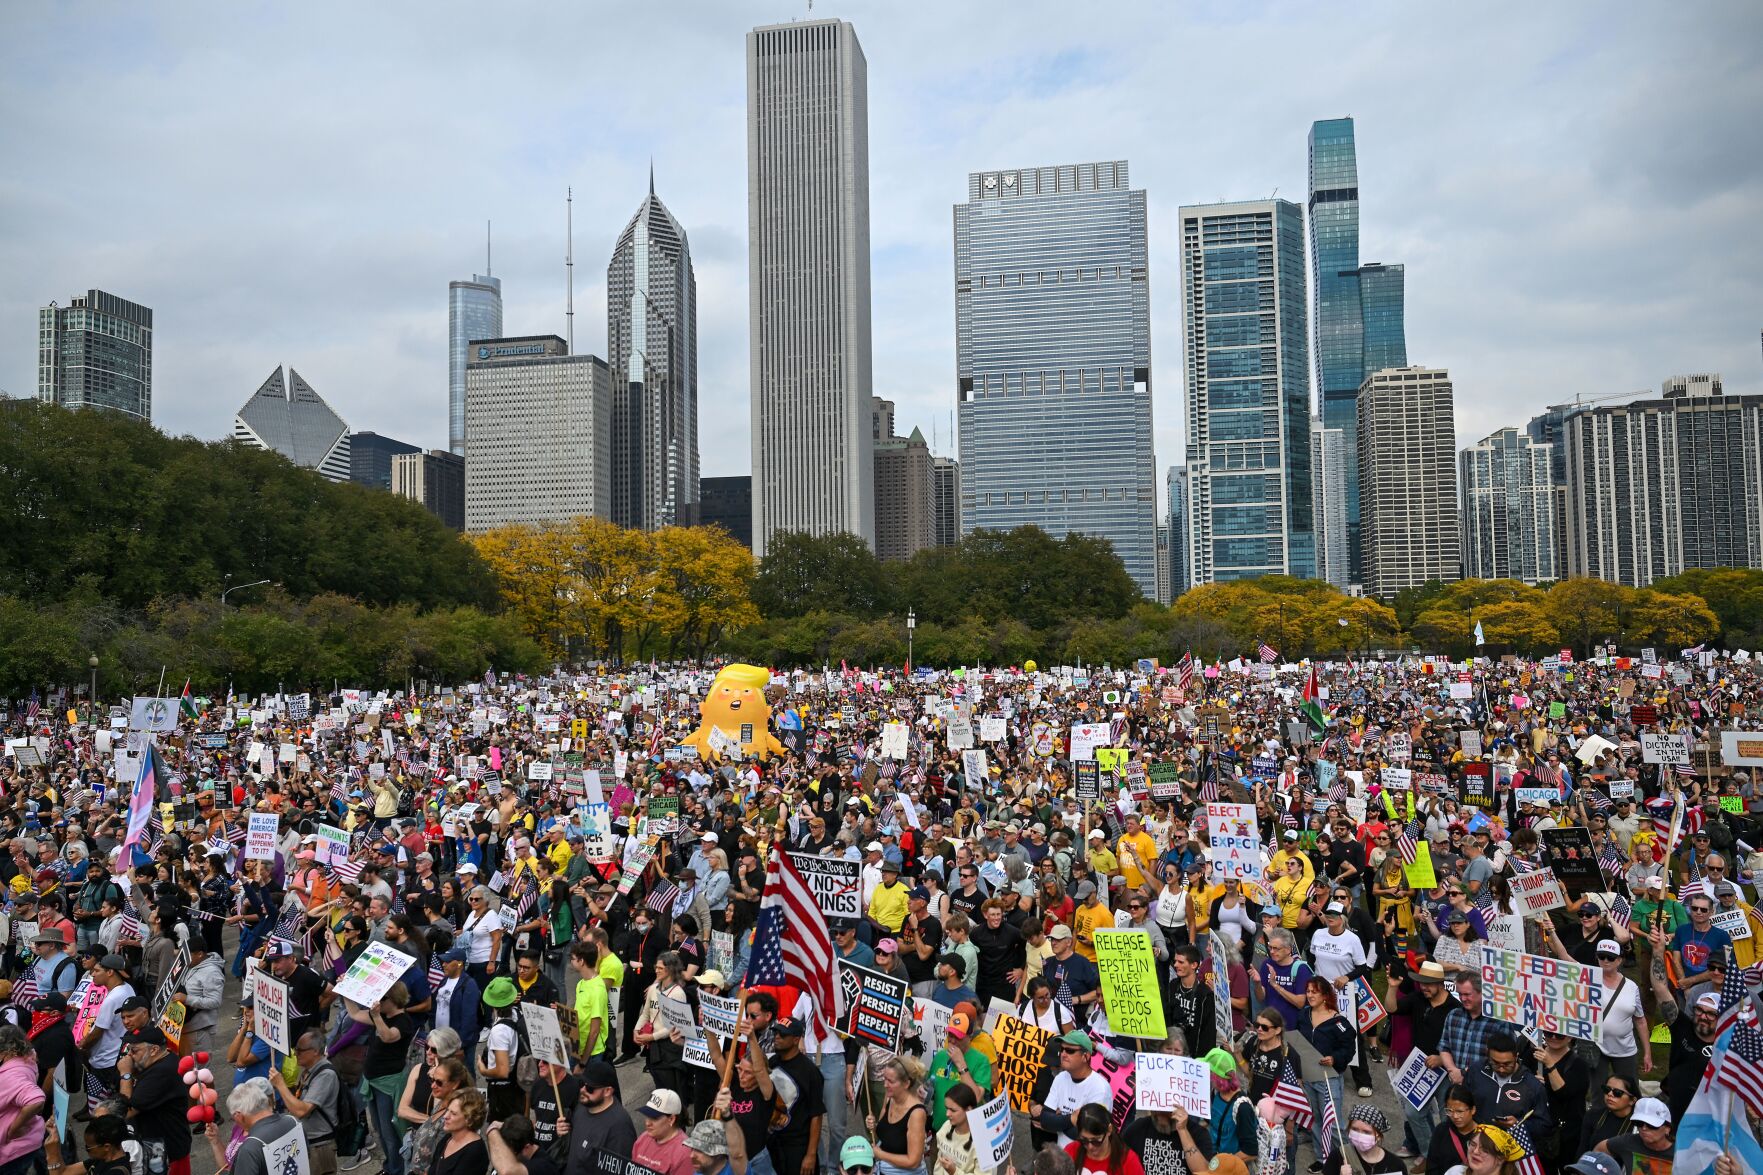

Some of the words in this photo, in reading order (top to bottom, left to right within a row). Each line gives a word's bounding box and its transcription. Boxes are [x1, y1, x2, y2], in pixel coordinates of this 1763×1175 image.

[495, 344, 544, 355] Prudential
[1645, 741, 1685, 749] DICTATOR
[1149, 767, 1176, 775] CHICAGO
[1516, 789, 1559, 799] CHICAGO
[1208, 806, 1241, 817] ELECT
[262, 817, 276, 825] LOVE
[1219, 822, 1228, 833] A
[320, 825, 349, 844] IMMIGRANTS
[583, 833, 603, 843] UCK
[1211, 836, 1257, 849] EXPECT
[248, 840, 274, 848] HAPPENING
[1230, 848, 1239, 859] A
[793, 855, 808, 869] We
[822, 860, 853, 876] People
[1215, 861, 1260, 878] CIRCUS
[814, 874, 834, 892] NO
[1521, 873, 1545, 892] DUMP
[1525, 890, 1560, 911] TRUMP!
[1709, 914, 1726, 925] ANDS
[1727, 912, 1741, 920] OFF
[1095, 934, 1146, 951] RELEASE
[1118, 950, 1132, 958] THE
[1099, 958, 1149, 973] EPSTEIN
[1482, 947, 1516, 970] THE
[1520, 955, 1602, 988] FEDERAL
[864, 976, 898, 998] RESIST.
[1109, 973, 1142, 983] FILES!
[1482, 965, 1532, 991] GOV'T
[1541, 977, 1557, 997] IS
[1563, 982, 1602, 1007] OUR
[257, 980, 283, 1008] ABOLISH
[1113, 984, 1145, 998] MAKE
[700, 992, 722, 1008] HANDS
[723, 1001, 739, 1012] OFF
[860, 994, 899, 1018] PERSIST.
[1110, 999, 1151, 1015] PEDOS
[258, 1000, 266, 1013] THE
[266, 1003, 282, 1023] SECRET
[1483, 1000, 1517, 1022] OUR
[1524, 1009, 1599, 1040] MASTER!
[1563, 1001, 1602, 1024] NOT
[261, 1018, 280, 1044] POLICE
[703, 1014, 741, 1037] CHICAG
[858, 1012, 896, 1036] REPEAT.
[995, 1013, 1002, 1030] I
[1003, 1016, 1055, 1047] SPEAK
[1121, 1016, 1150, 1035] PAY!
[685, 1047, 713, 1063] CHICAG
[1003, 1036, 1040, 1063] FOR
[997, 1051, 1037, 1081] HOS
[1137, 1054, 1174, 1071] FUCK
[1182, 1060, 1203, 1078] ICE
[1169, 1076, 1199, 1095] FREE
[1141, 1090, 1209, 1117] PALESTINE
[273, 1138, 298, 1162] STOP
[1143, 1147, 1180, 1159] HISTORY
[1145, 1138, 1173, 1150] BLACK
[597, 1151, 622, 1175] WHEN
[1142, 1154, 1182, 1167] CHICAGO
[1144, 1162, 1187, 1175] TEACHERS
